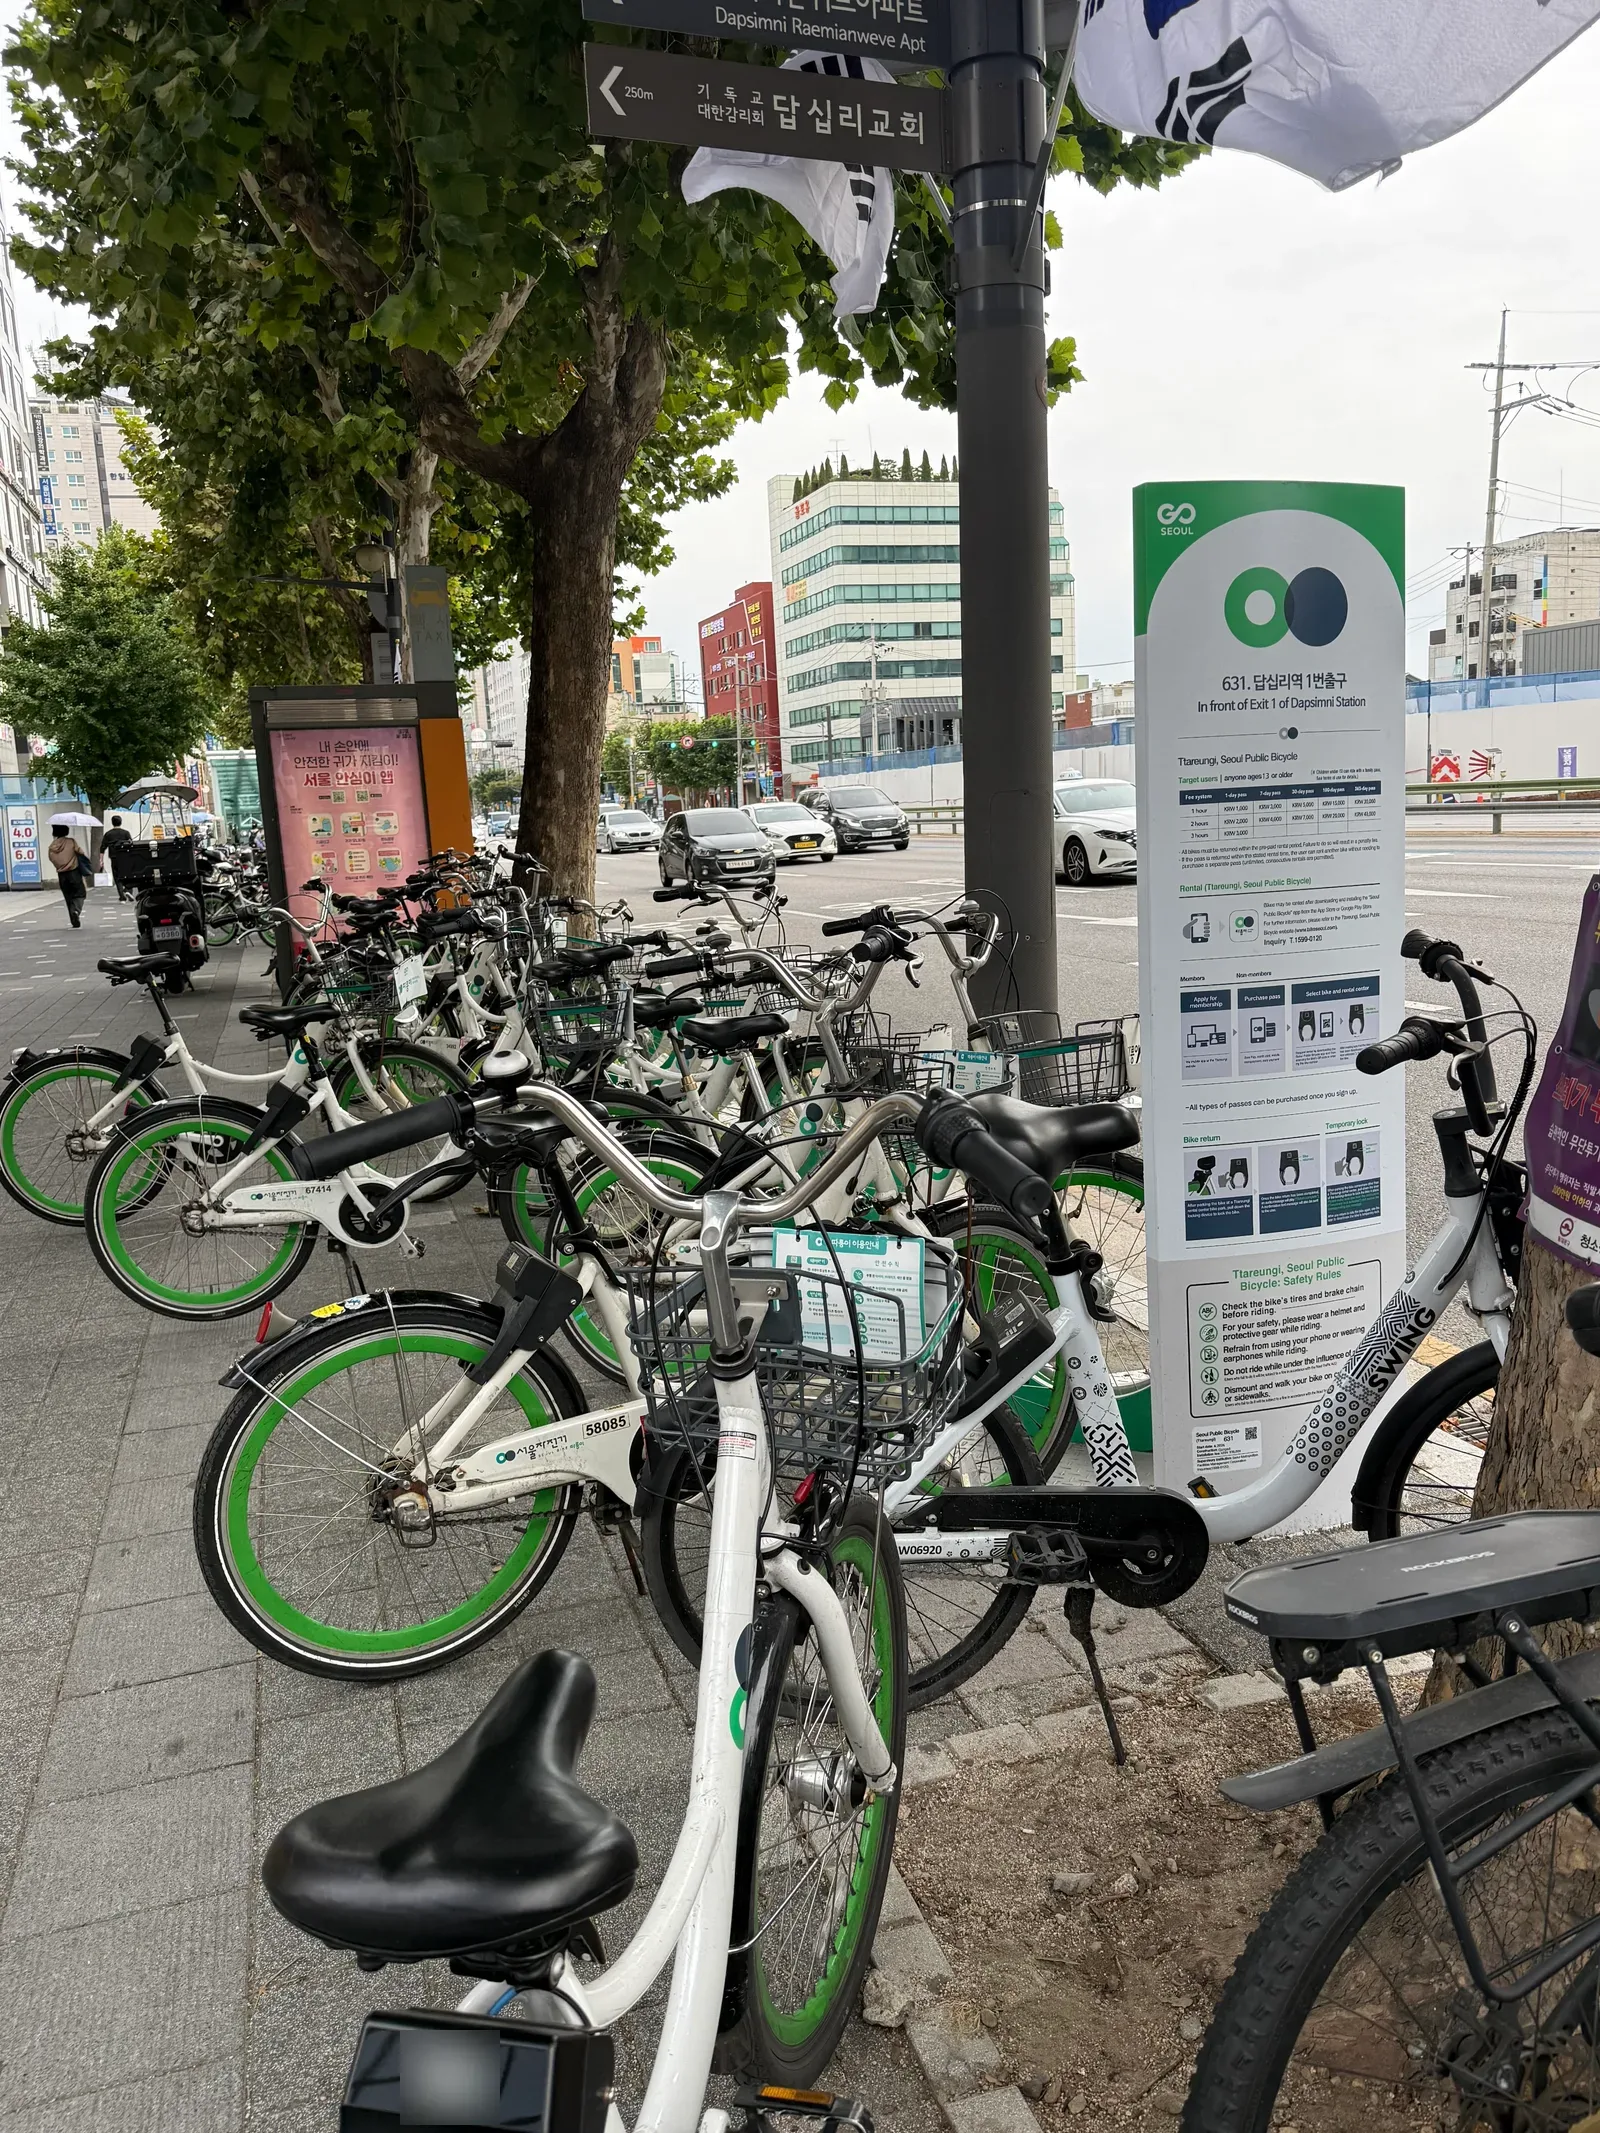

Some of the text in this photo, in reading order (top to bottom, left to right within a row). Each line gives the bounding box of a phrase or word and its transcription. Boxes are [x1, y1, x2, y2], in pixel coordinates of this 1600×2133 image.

[716, 7, 786, 33] Dapsimni
[792, 17, 895, 47] Raemianweve
[900, 33, 925, 54] Apt
[625, 86, 653, 100] 250m
[698, 103, 764, 126] 대한감리회
[773, 95, 924, 144] 답십리교회
[1161, 527, 1193, 535] SEOUL
[1222, 673, 1347, 691] 631. 답십리역 1번출구
[1198, 696, 1366, 712] In front of Exit 1 of Dapsimni Station
[319, 740, 369, 753] 내 손안에
[294, 754, 398, 768] 안전한 귀가 지킴이!
[1178, 752, 1298, 766] Ttareungi, Seoul Public Bicycle
[304, 771, 393, 786] 서울 안심이 앱
[1265, 879, 1285, 887] Public
[1287, 877, 1311, 886] Bicycle)
[1264, 938, 1286, 946] Inquiry
[1190, 1001, 1222, 1009] membership
[1270, 993, 1280, 1001] pass
[1199, 1103, 1217, 1112] types
[1229, 1101, 1251, 1110] passes
[1276, 1094, 1308, 1105] purchased
[1337, 1089, 1348, 1098] sign
[1349, 1088, 1357, 1096] up.
[1326, 1120, 1355, 1130] Temporary
[306, 1185, 331, 1194] 67414
[1572, 1194, 1592, 1211] 이하의
[831, 1239, 879, 1249] 따릉이 이용안내
[1580, 1234, 1600, 1253] 청소
[1233, 1256, 1344, 1279] Ttareungi, Seoul Public
[1241, 1270, 1341, 1291] Bicycle: Safety Rules
[1222, 1284, 1364, 1311] Check the bike's tires and brake chain
[1223, 1307, 1276, 1319] before riding.
[1238, 1322, 1254, 1331] your
[1257, 1319, 1280, 1328] safety,
[1283, 1316, 1305, 1326] please
[1331, 1307, 1352, 1317] helmet
[1354, 1304, 1365, 1312] and
[1223, 1322, 1322, 1342] protective gear while riding.
[1224, 1344, 1250, 1353] Refrain
[1252, 1342, 1269, 1351] from
[1271, 1340, 1291, 1349] using
[1310, 1333, 1331, 1343] phone
[1341, 1326, 1365, 1337] wearing
[1224, 1346, 1308, 1363] earphones while riding.
[1368, 1307, 1436, 1393] SWING
[1224, 1368, 1234, 1376] Do
[1236, 1366, 1248, 1374] not
[1249, 1364, 1263, 1372] ride
[1264, 1362, 1282, 1370] while
[1284, 1359, 1303, 1369] under
[1305, 1357, 1315, 1365] the
[1316, 1352, 1344, 1363] influence
[1345, 1350, 1352, 1358] of
[1225, 1384, 1257, 1394] Dismount
[1260, 1382, 1273, 1390] and
[1275, 1379, 1291, 1387] walk
[1293, 1377, 1307, 1386] your
[1309, 1374, 1323, 1382] bike
[1235, 1391, 1270, 1401] sidewalks.
[586, 1415, 626, 1436] 58085
[1400, 1550, 1496, 1573] ROCKBROS
[1228, 1603, 1259, 1625] ROCKBROS
